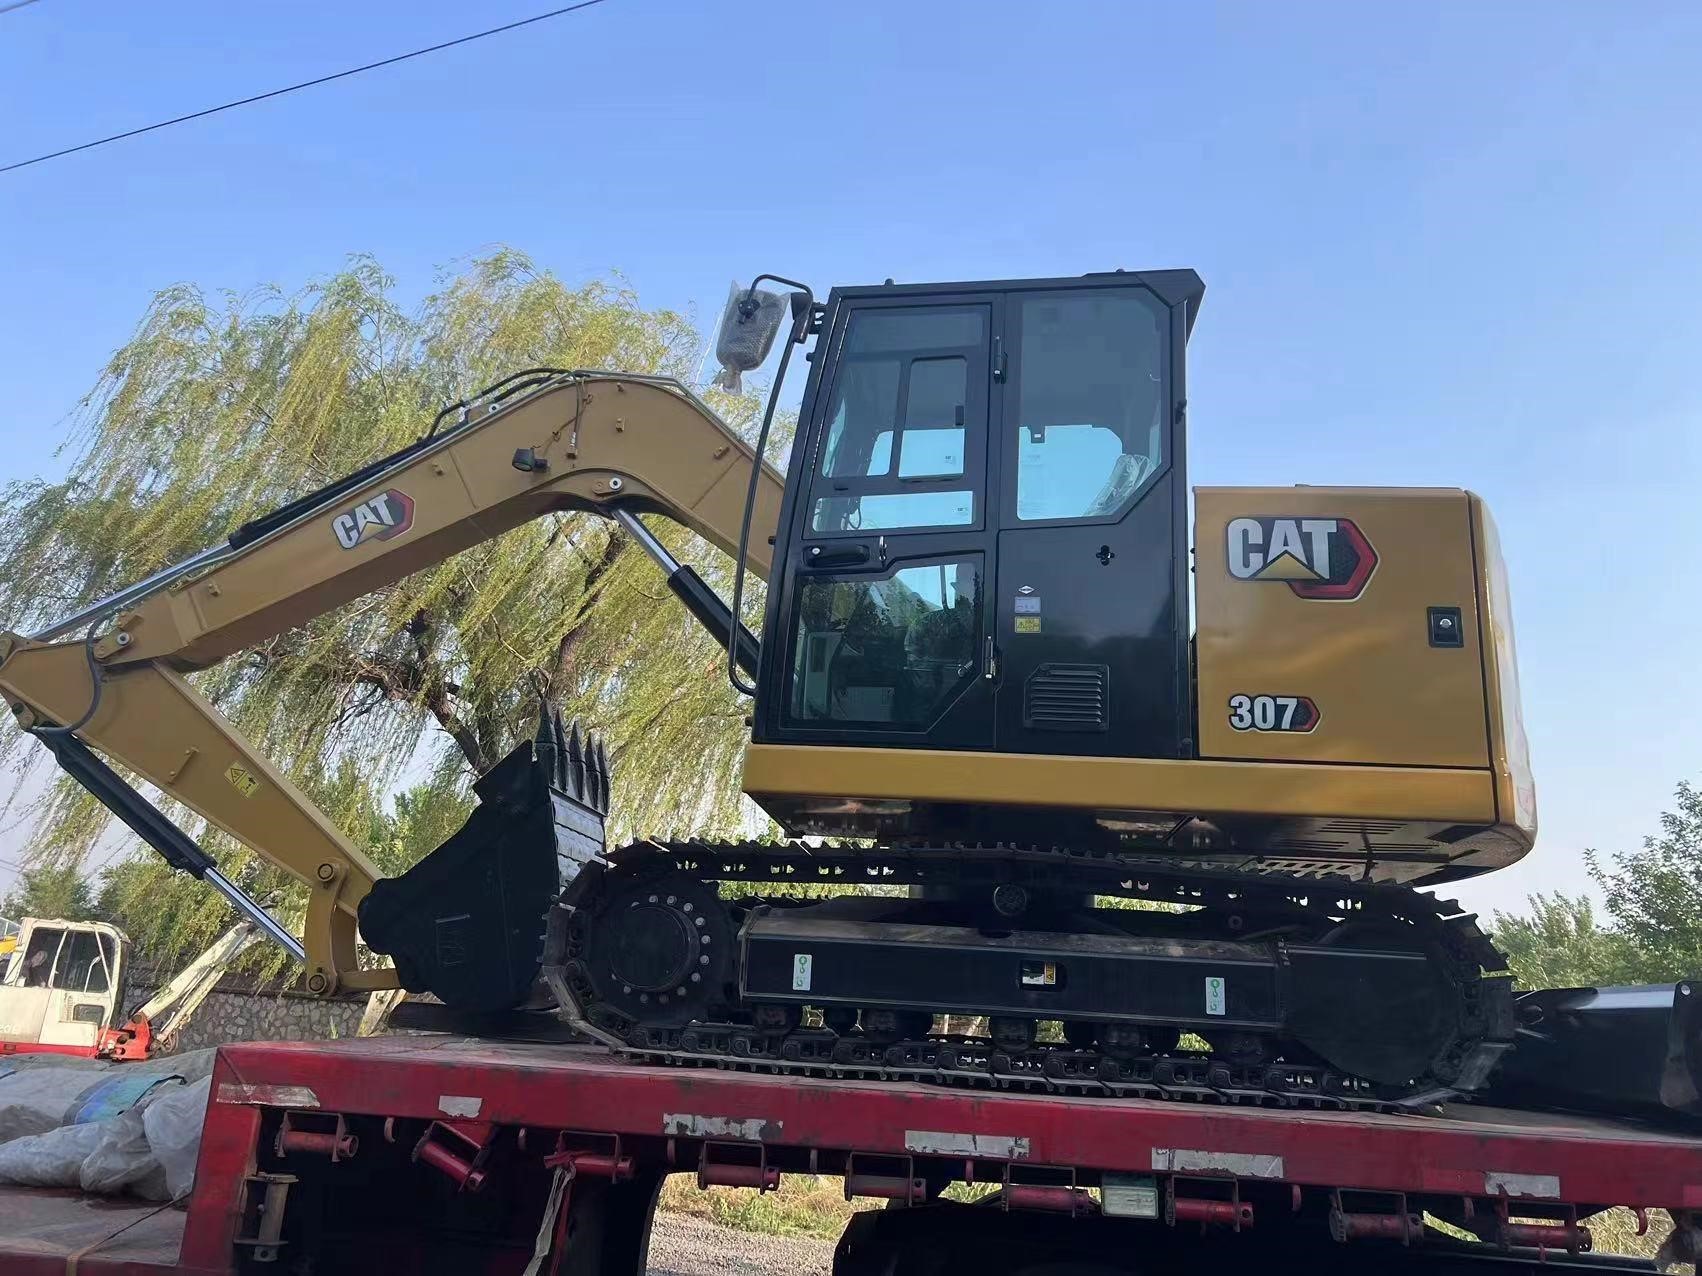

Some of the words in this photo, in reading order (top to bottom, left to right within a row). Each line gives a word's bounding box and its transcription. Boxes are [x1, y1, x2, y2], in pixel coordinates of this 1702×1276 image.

[332, 493, 395, 549] CAT
[1227, 518, 1337, 579] CAT
[1229, 695, 1298, 730] 307
